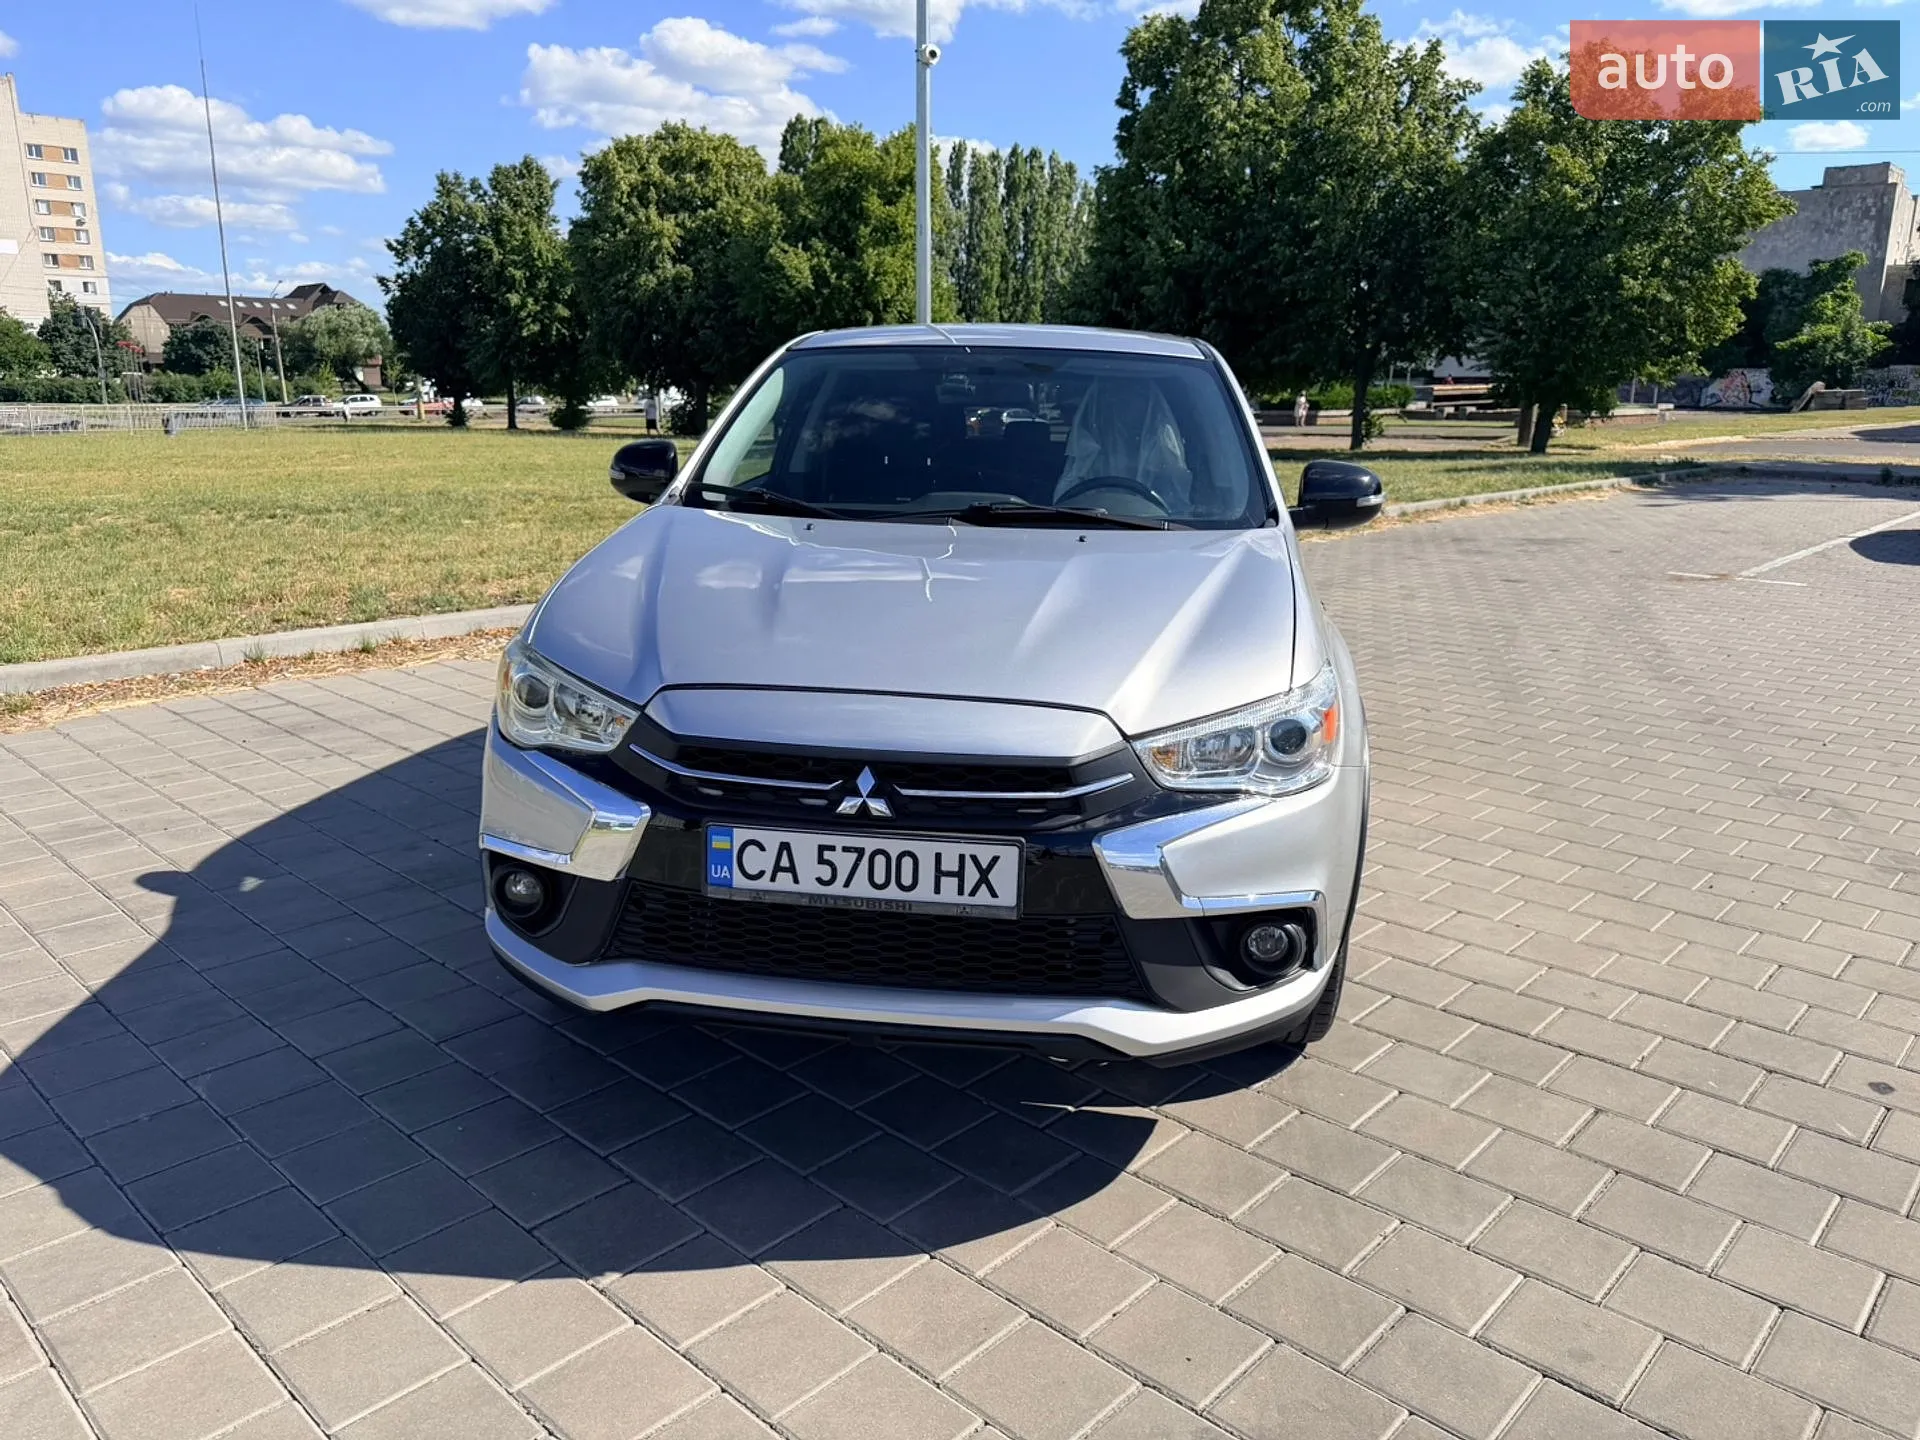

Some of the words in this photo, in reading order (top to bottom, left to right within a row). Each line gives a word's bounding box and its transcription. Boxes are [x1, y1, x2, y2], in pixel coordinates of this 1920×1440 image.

[711, 864, 731, 879] UA
[736, 838, 800, 885] CA
[814, 844, 919, 892] 5700
[933, 852, 1001, 899] HX
